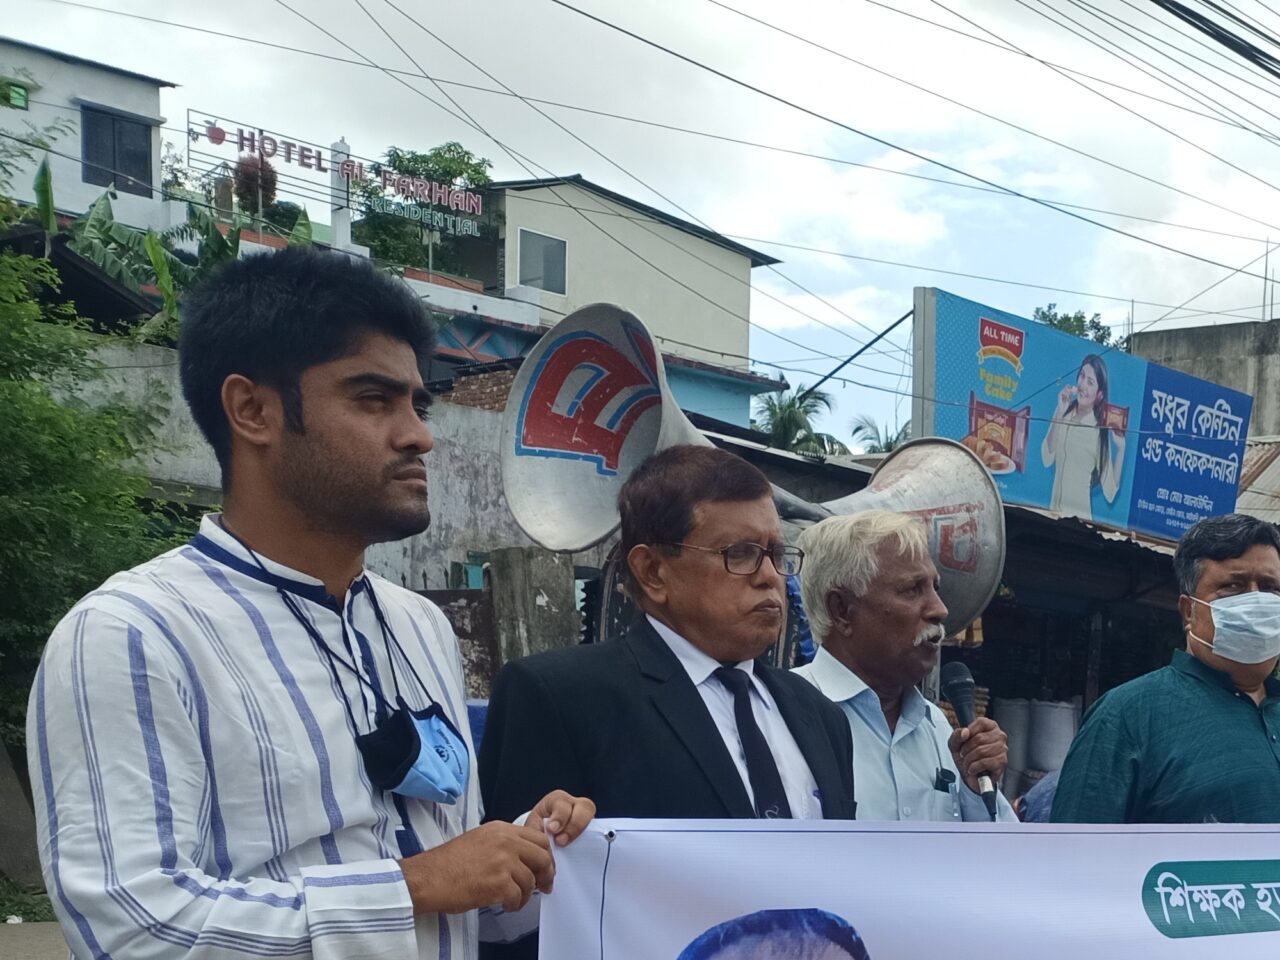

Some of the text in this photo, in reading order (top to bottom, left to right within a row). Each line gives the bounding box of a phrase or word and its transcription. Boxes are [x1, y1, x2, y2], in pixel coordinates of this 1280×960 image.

[236, 127, 483, 215] HOTEL AL FARHAN
[371, 198, 480, 237] RESIDENTIAL
[983, 325, 1020, 346] ALL TIME
[1151, 389, 1190, 438] মধুর
[1165, 442, 1239, 485] কনফেকশনারী
[1154, 871, 1245, 924] শিক্ষক
